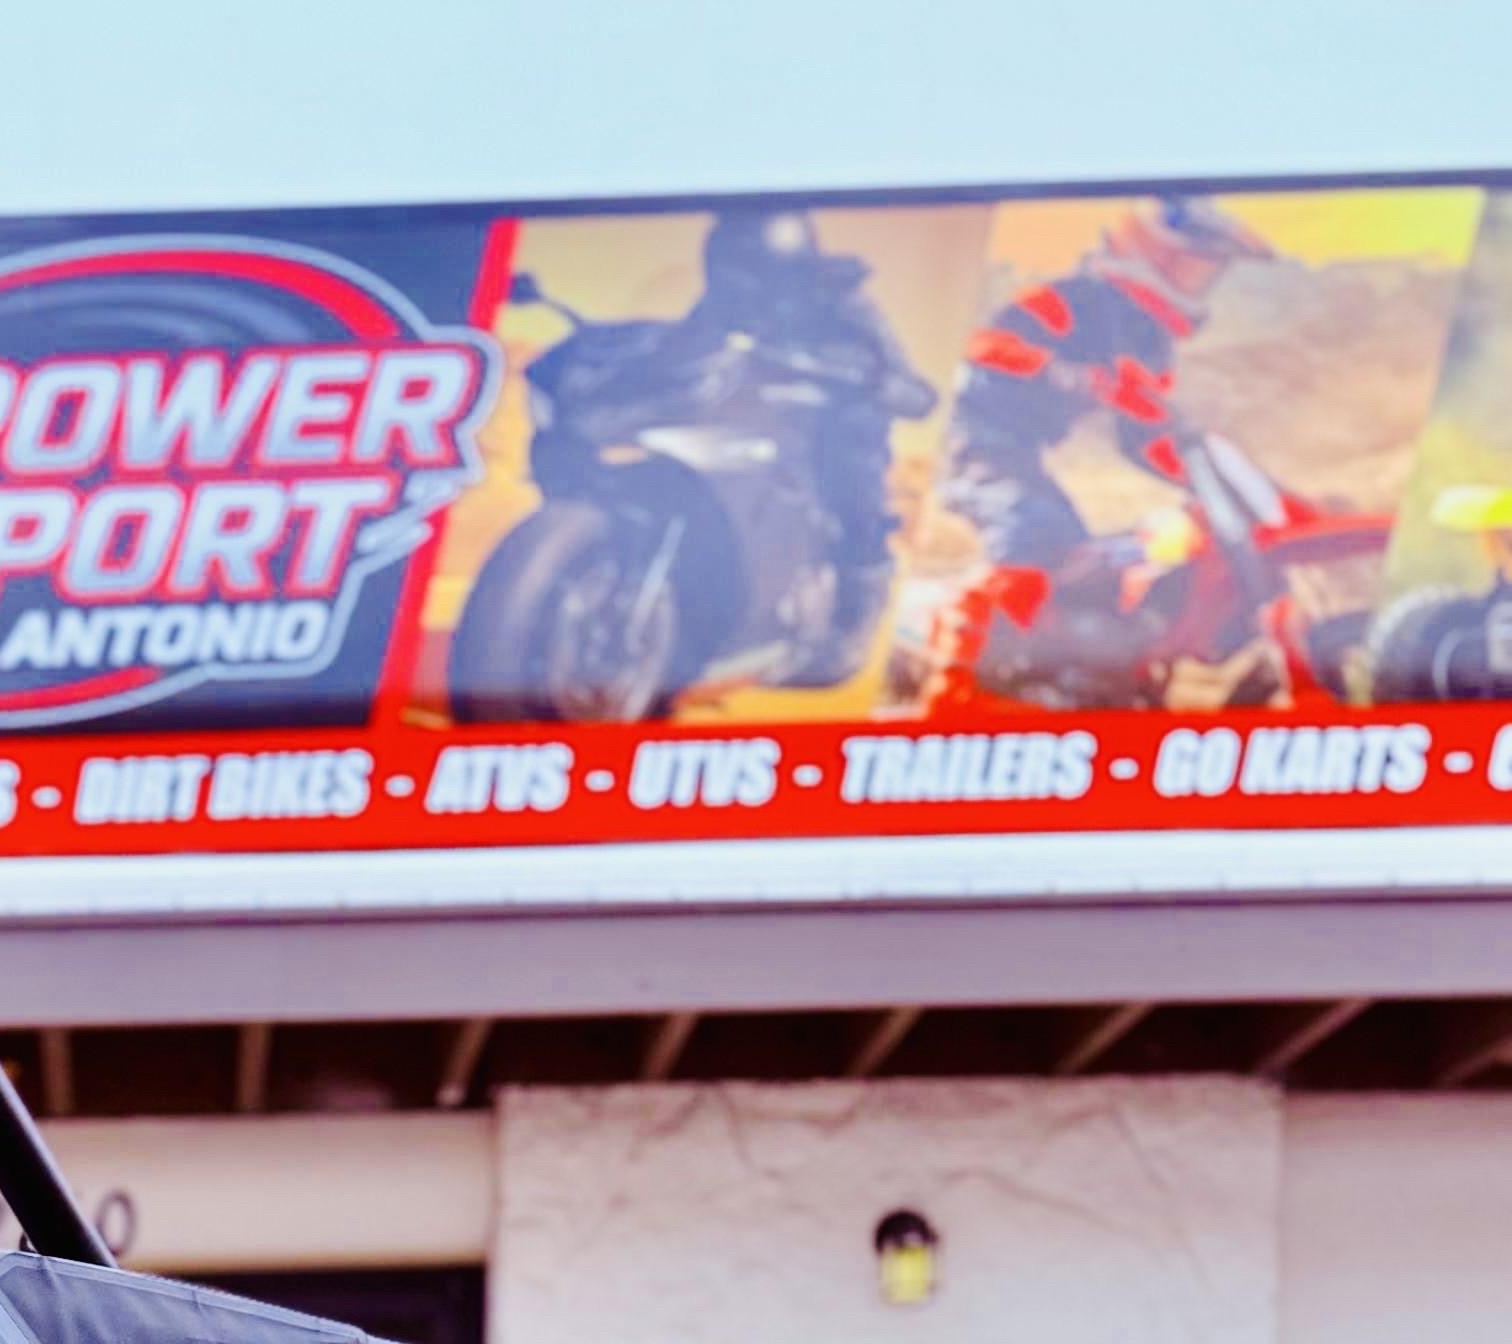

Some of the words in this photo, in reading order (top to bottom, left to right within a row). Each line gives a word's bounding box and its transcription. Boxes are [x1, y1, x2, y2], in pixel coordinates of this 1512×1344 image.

[72, 754, 210, 825] DIRT
[207, 748, 374, 821] BIKES
[425, 742, 573, 812] ATVS
[627, 737, 781, 809] UTVS
[840, 730, 1097, 805] TRAILERS
[1152, 727, 1243, 798] GO
[1238, 722, 1433, 795] KARTS
